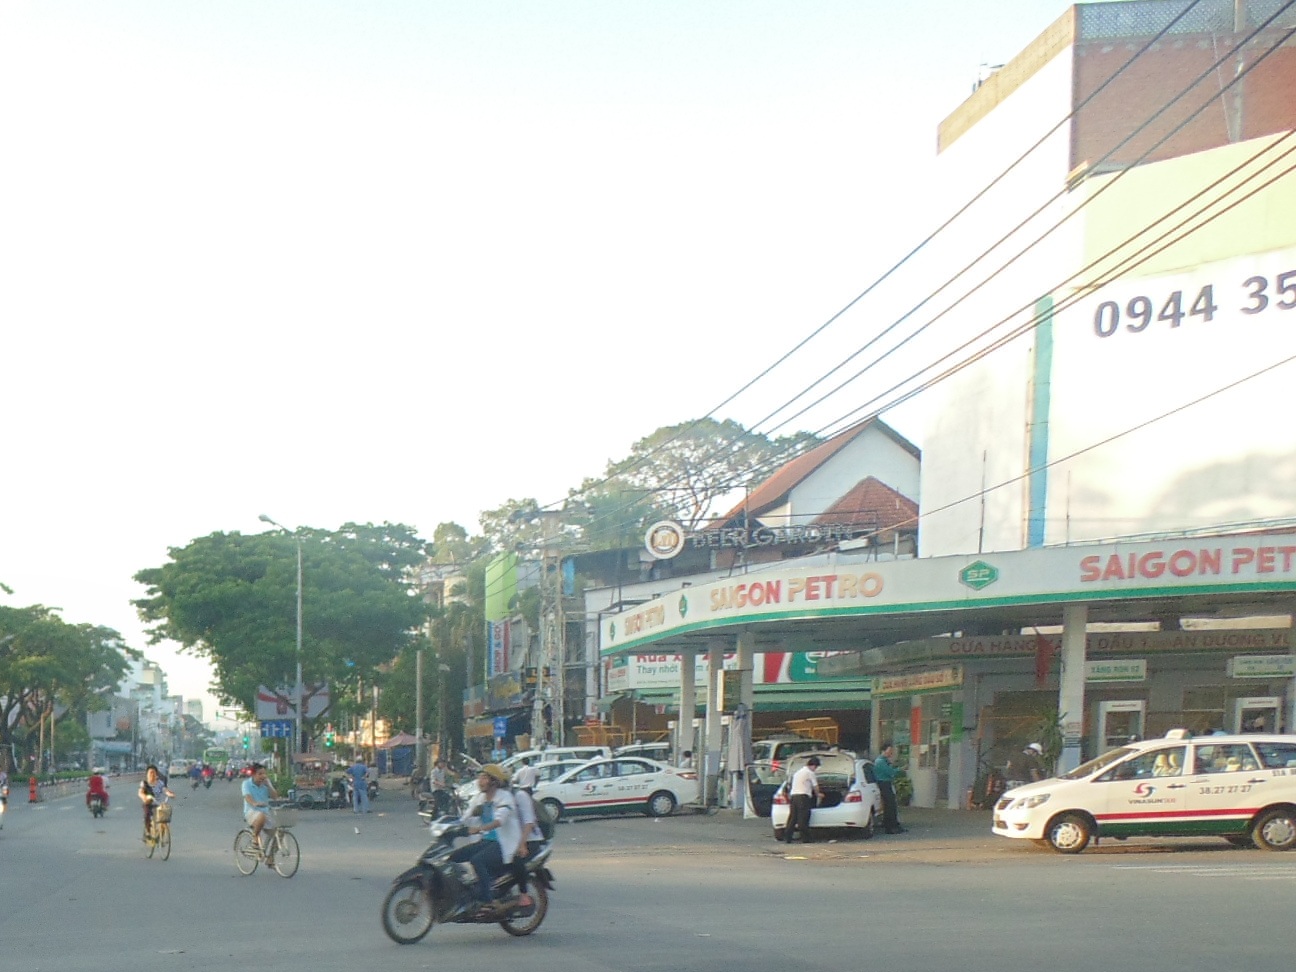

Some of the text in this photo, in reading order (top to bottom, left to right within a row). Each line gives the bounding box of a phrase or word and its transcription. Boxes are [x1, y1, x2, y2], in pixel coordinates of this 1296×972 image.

[1093, 270, 1296, 338] 0944 35
[1080, 549, 1222, 583] SAIGON
[710, 572, 884, 612] SAIGON PETRO
[636, 665, 656, 675] Thay
[1199, 784, 1252, 794] 38.27 27 27
